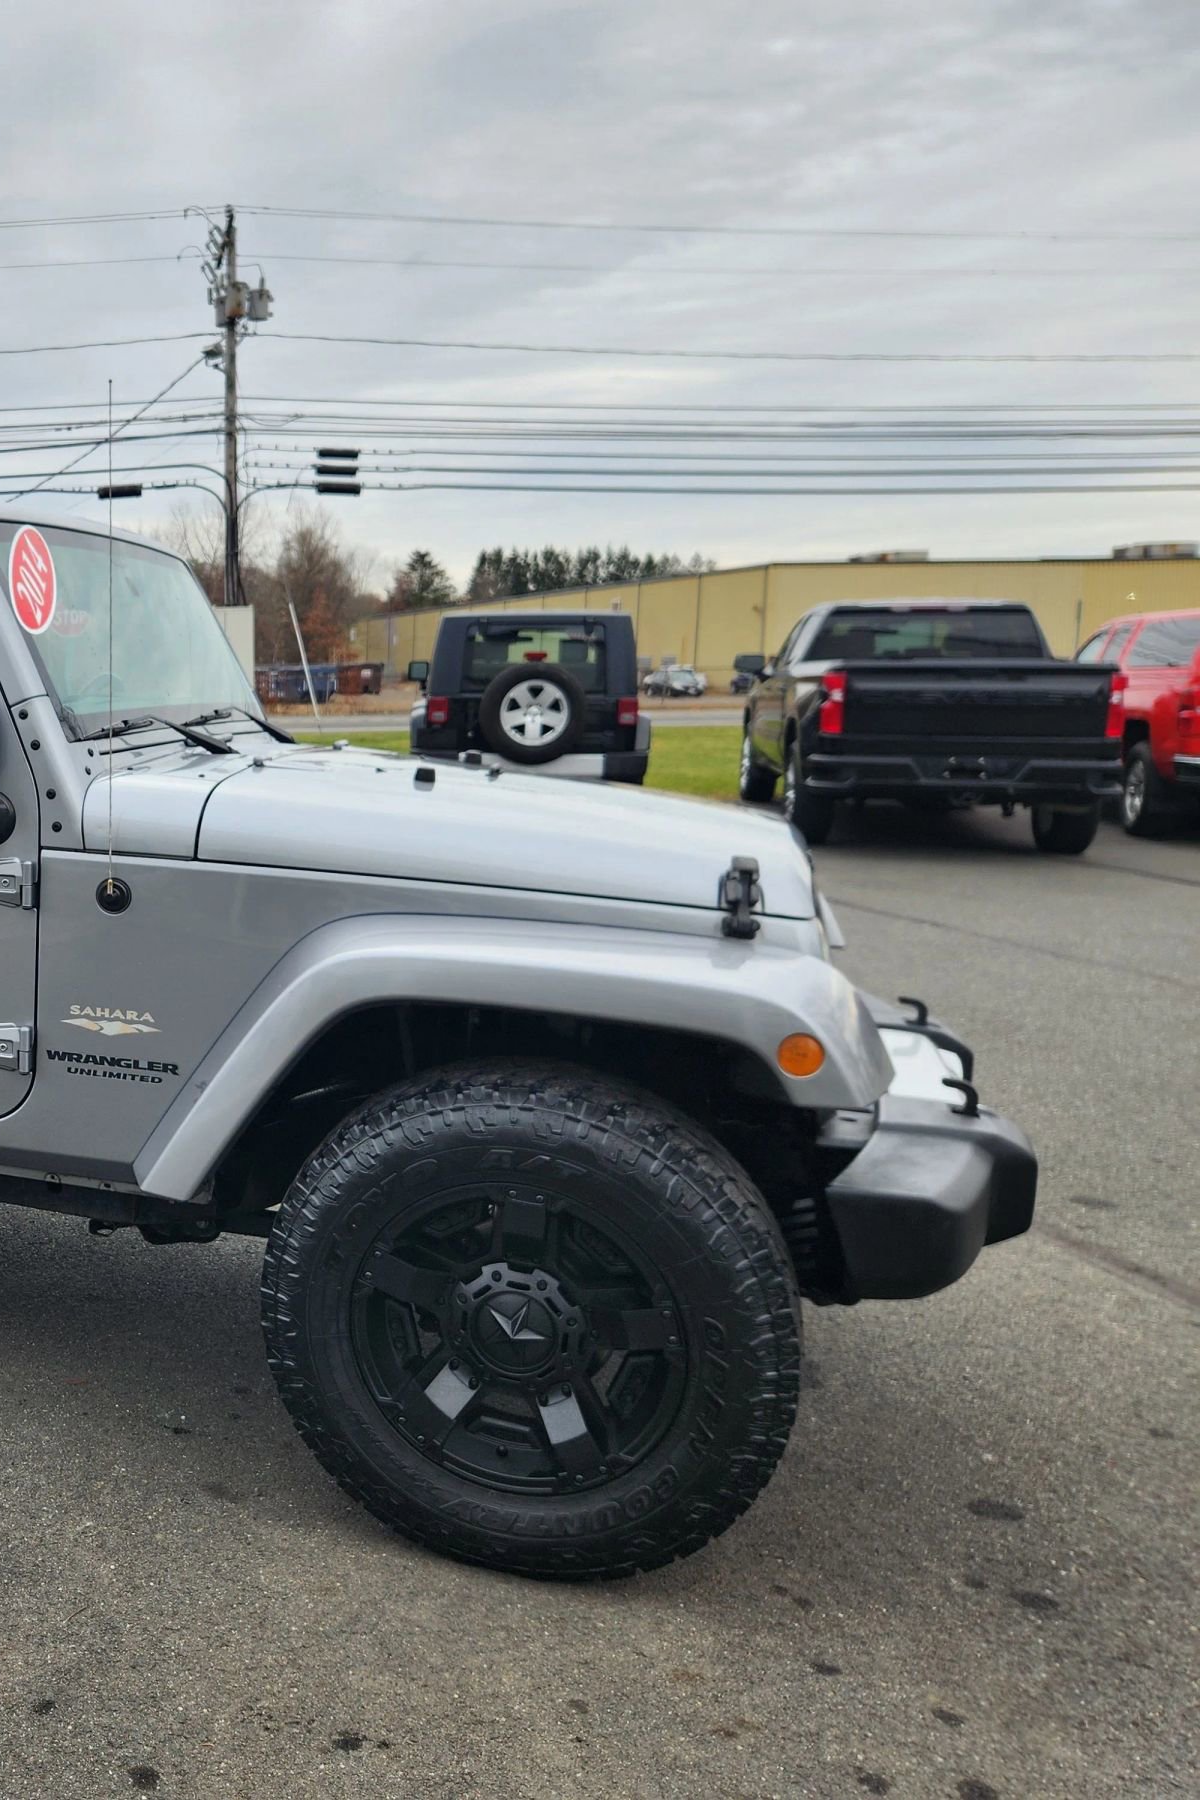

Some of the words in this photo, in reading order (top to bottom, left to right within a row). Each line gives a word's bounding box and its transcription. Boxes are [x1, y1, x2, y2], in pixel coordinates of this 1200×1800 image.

[16, 532, 48, 626] 2014
[53, 608, 88, 625] STOP
[69, 1004, 155, 1023] SAHARA
[46, 1049, 180, 1076] WRANGLER
[66, 1066, 163, 1084] UNLIMITED
[439, 1464, 680, 1538] COUNTRY
